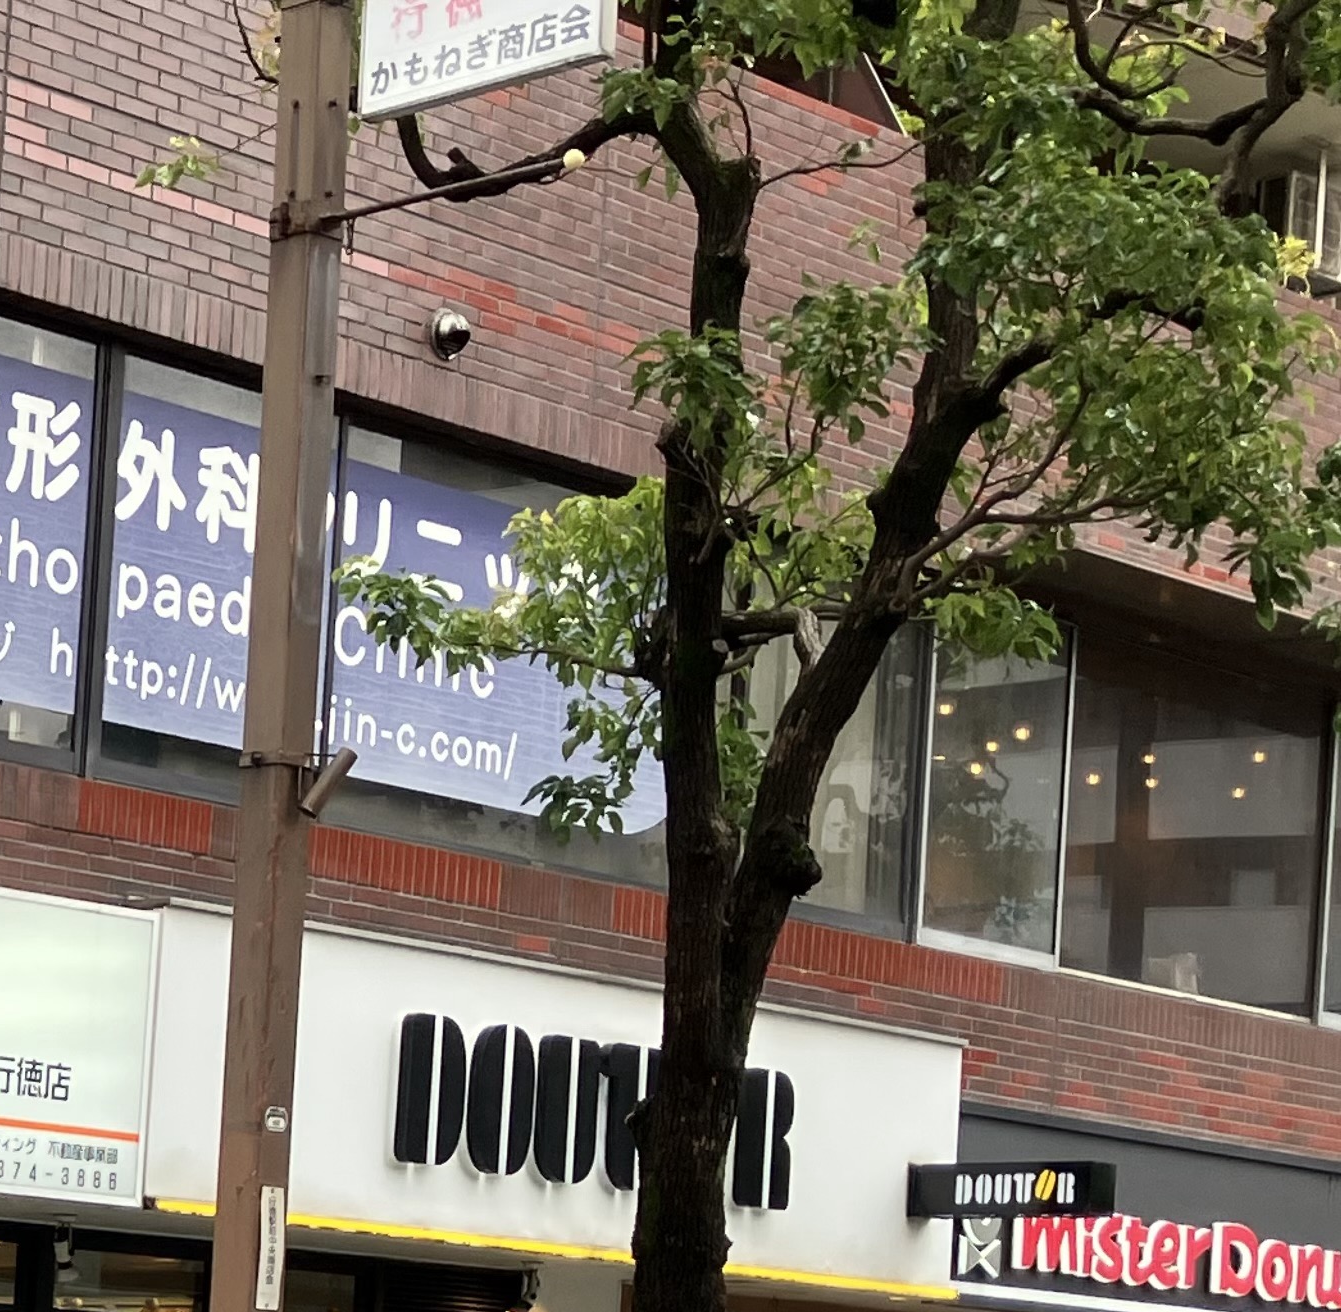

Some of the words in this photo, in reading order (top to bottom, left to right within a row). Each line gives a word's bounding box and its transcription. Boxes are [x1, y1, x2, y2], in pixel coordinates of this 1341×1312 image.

[370, 4, 591, 95] かもねぎ商店会
[393, 1011, 796, 1211] DOUTR
[954, 1169, 1076, 1206] DOUTOR
